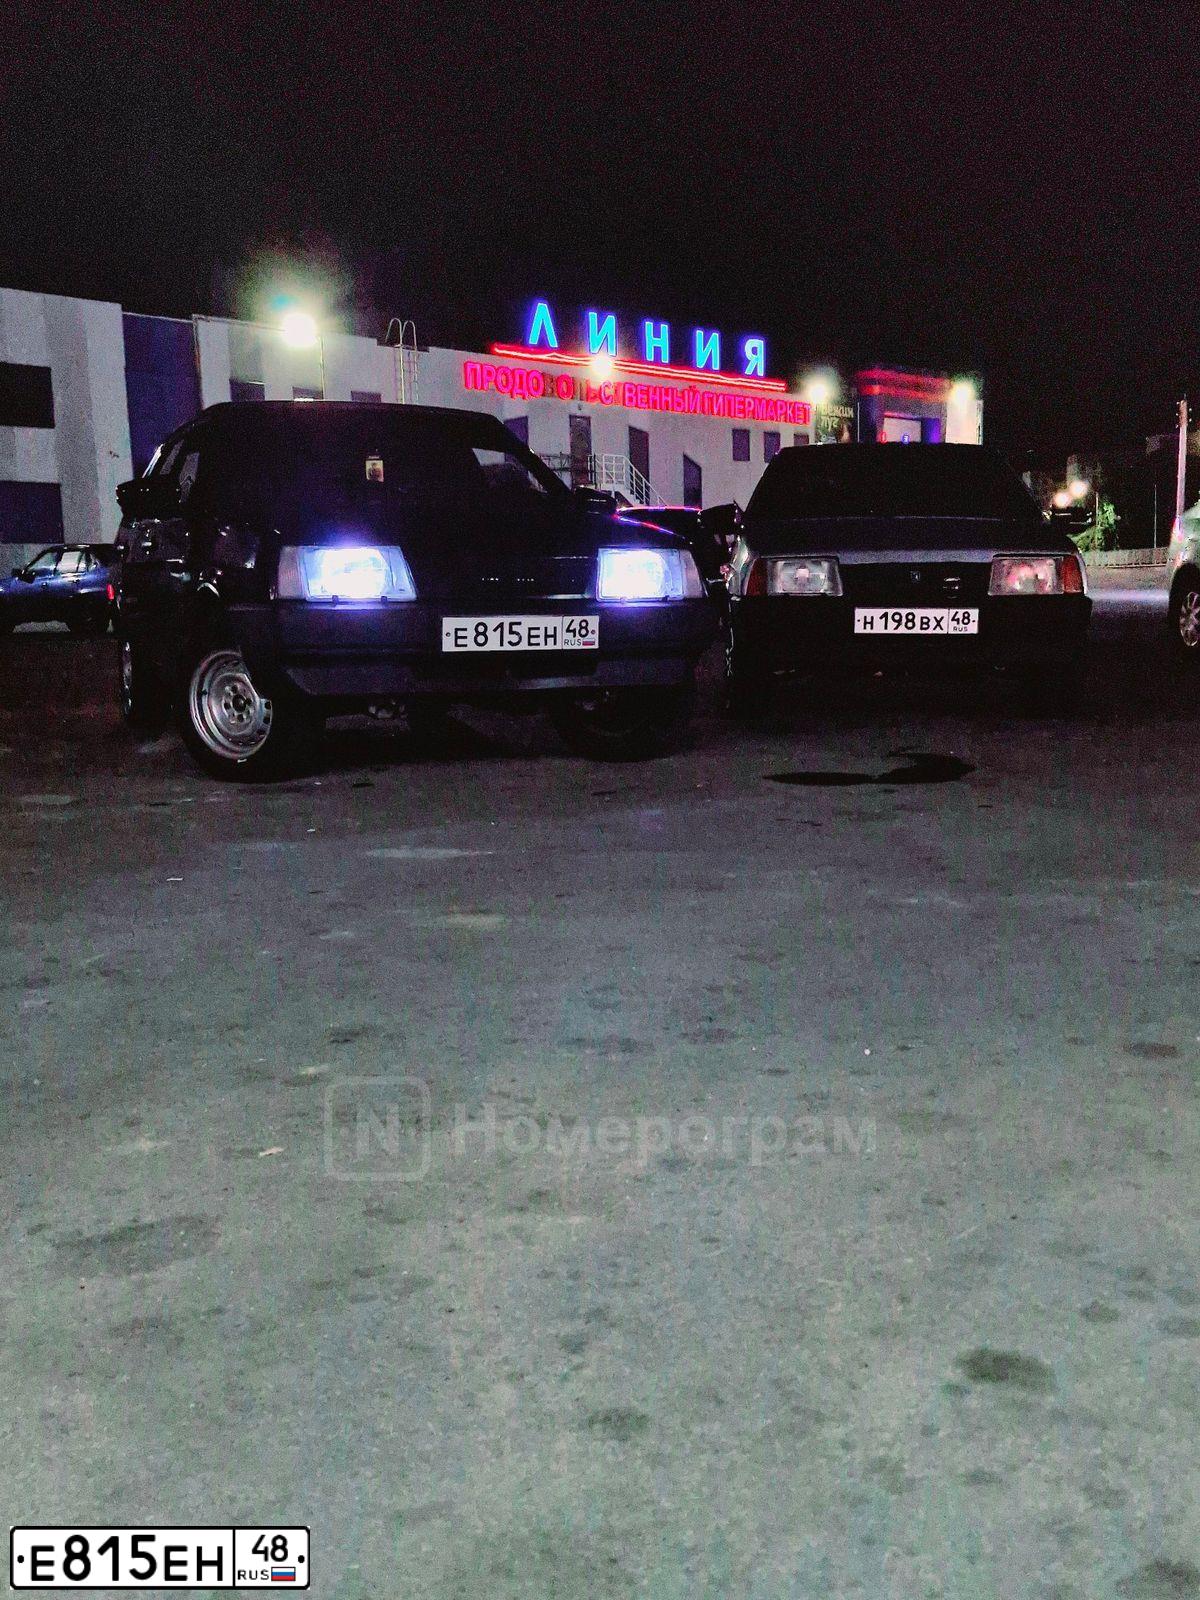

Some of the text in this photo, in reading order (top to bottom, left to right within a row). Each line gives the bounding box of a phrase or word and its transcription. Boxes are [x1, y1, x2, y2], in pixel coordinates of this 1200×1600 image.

[528, 302, 765, 377] ЛИНИЯ
[463, 360, 812, 426] ПРОДООСВЕННЫЙ ГИПЕРМАРКЕТ
[454, 619, 590, 648] Е815ЕН 48
[863, 611, 971, 631] Н198ВХ 48
[564, 638, 582, 646] RUS
